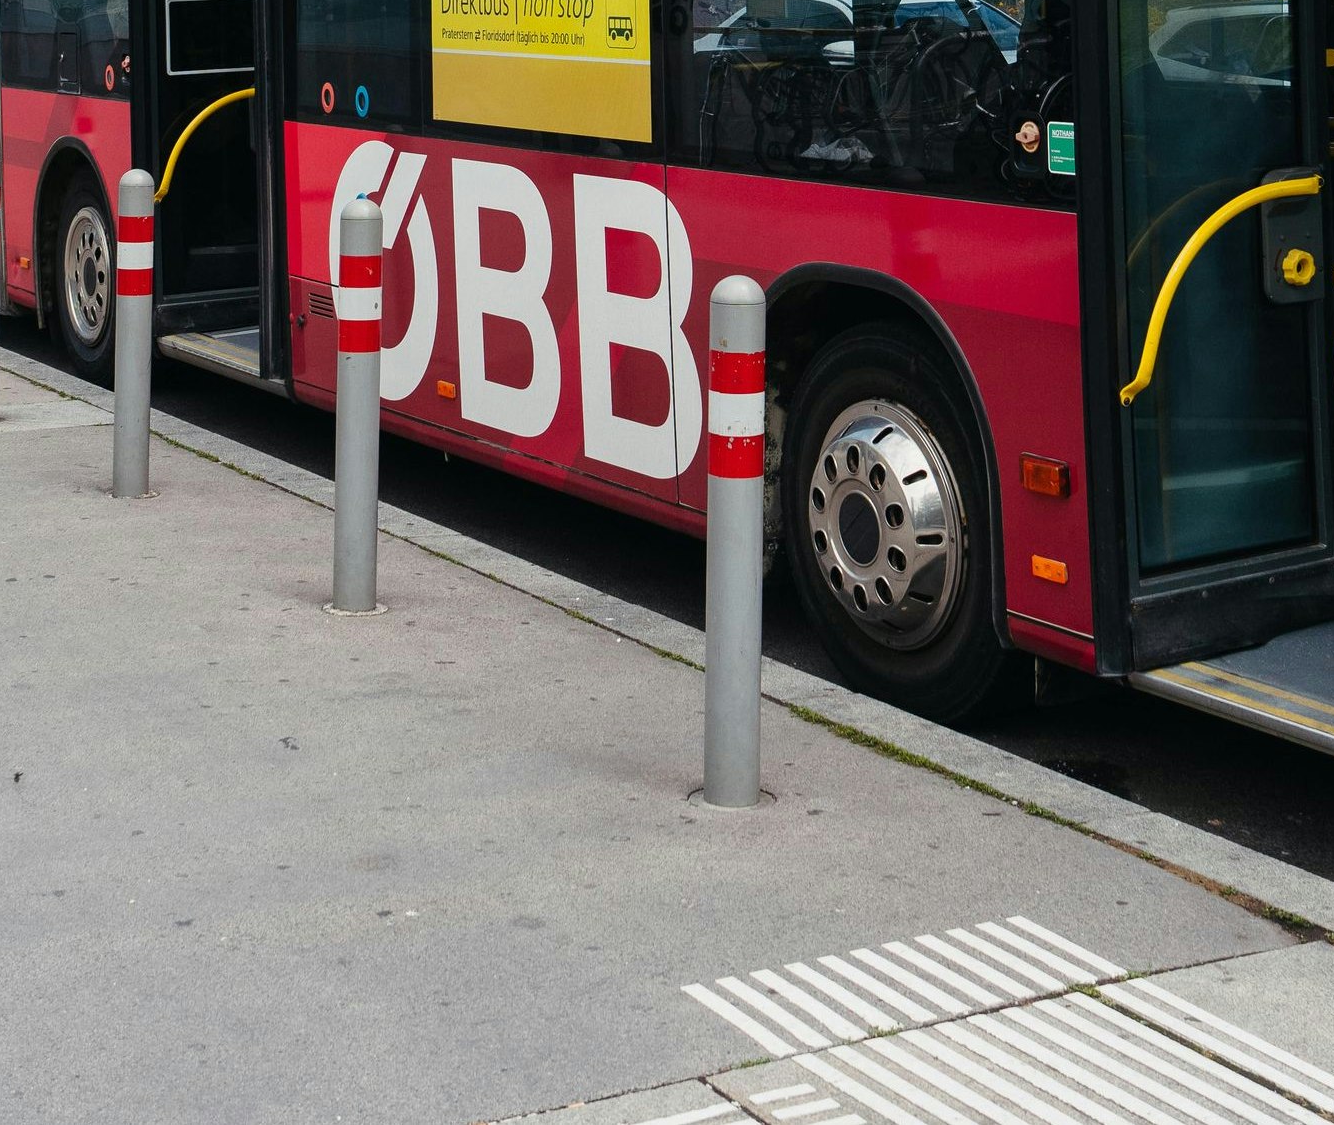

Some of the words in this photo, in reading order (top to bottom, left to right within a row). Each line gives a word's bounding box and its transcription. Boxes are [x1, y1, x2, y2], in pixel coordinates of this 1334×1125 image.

[441, 28, 474, 40] Praterstern
[482, 30, 515, 42] Floridsdorf
[517, 30, 539, 46] (täglich
[540, 32, 549, 43] bis
[550, 33, 570, 45] 20:00
[571, 33, 585, 46] Uhr)
